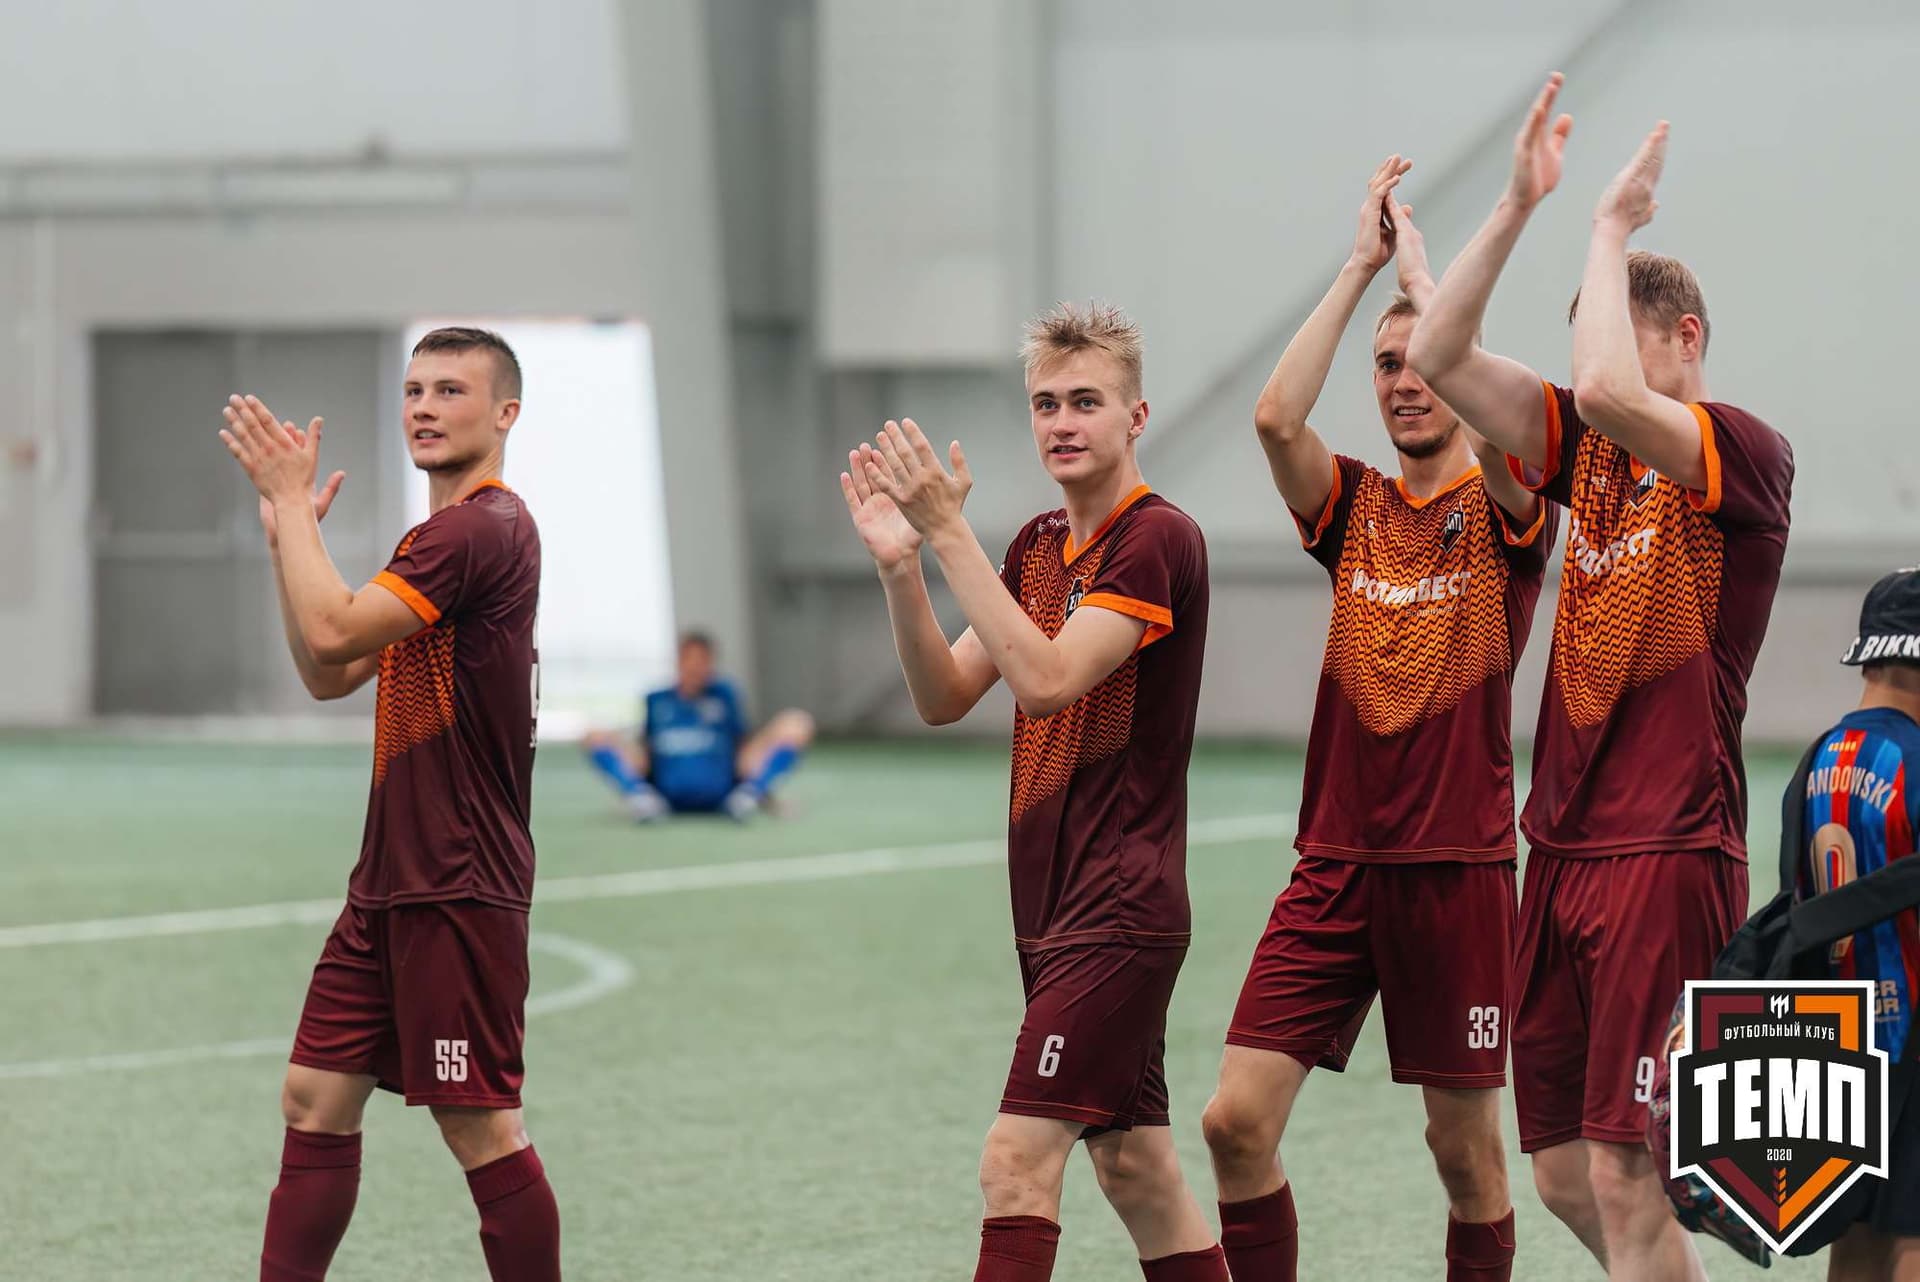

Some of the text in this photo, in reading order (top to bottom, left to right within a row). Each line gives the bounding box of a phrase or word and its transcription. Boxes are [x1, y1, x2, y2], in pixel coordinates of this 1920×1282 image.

[1468, 1006, 1500, 1049] 33
[435, 1039, 469, 1082] 55
[1037, 1034, 1065, 1077] 6
[1634, 1056, 1656, 1103] 9
